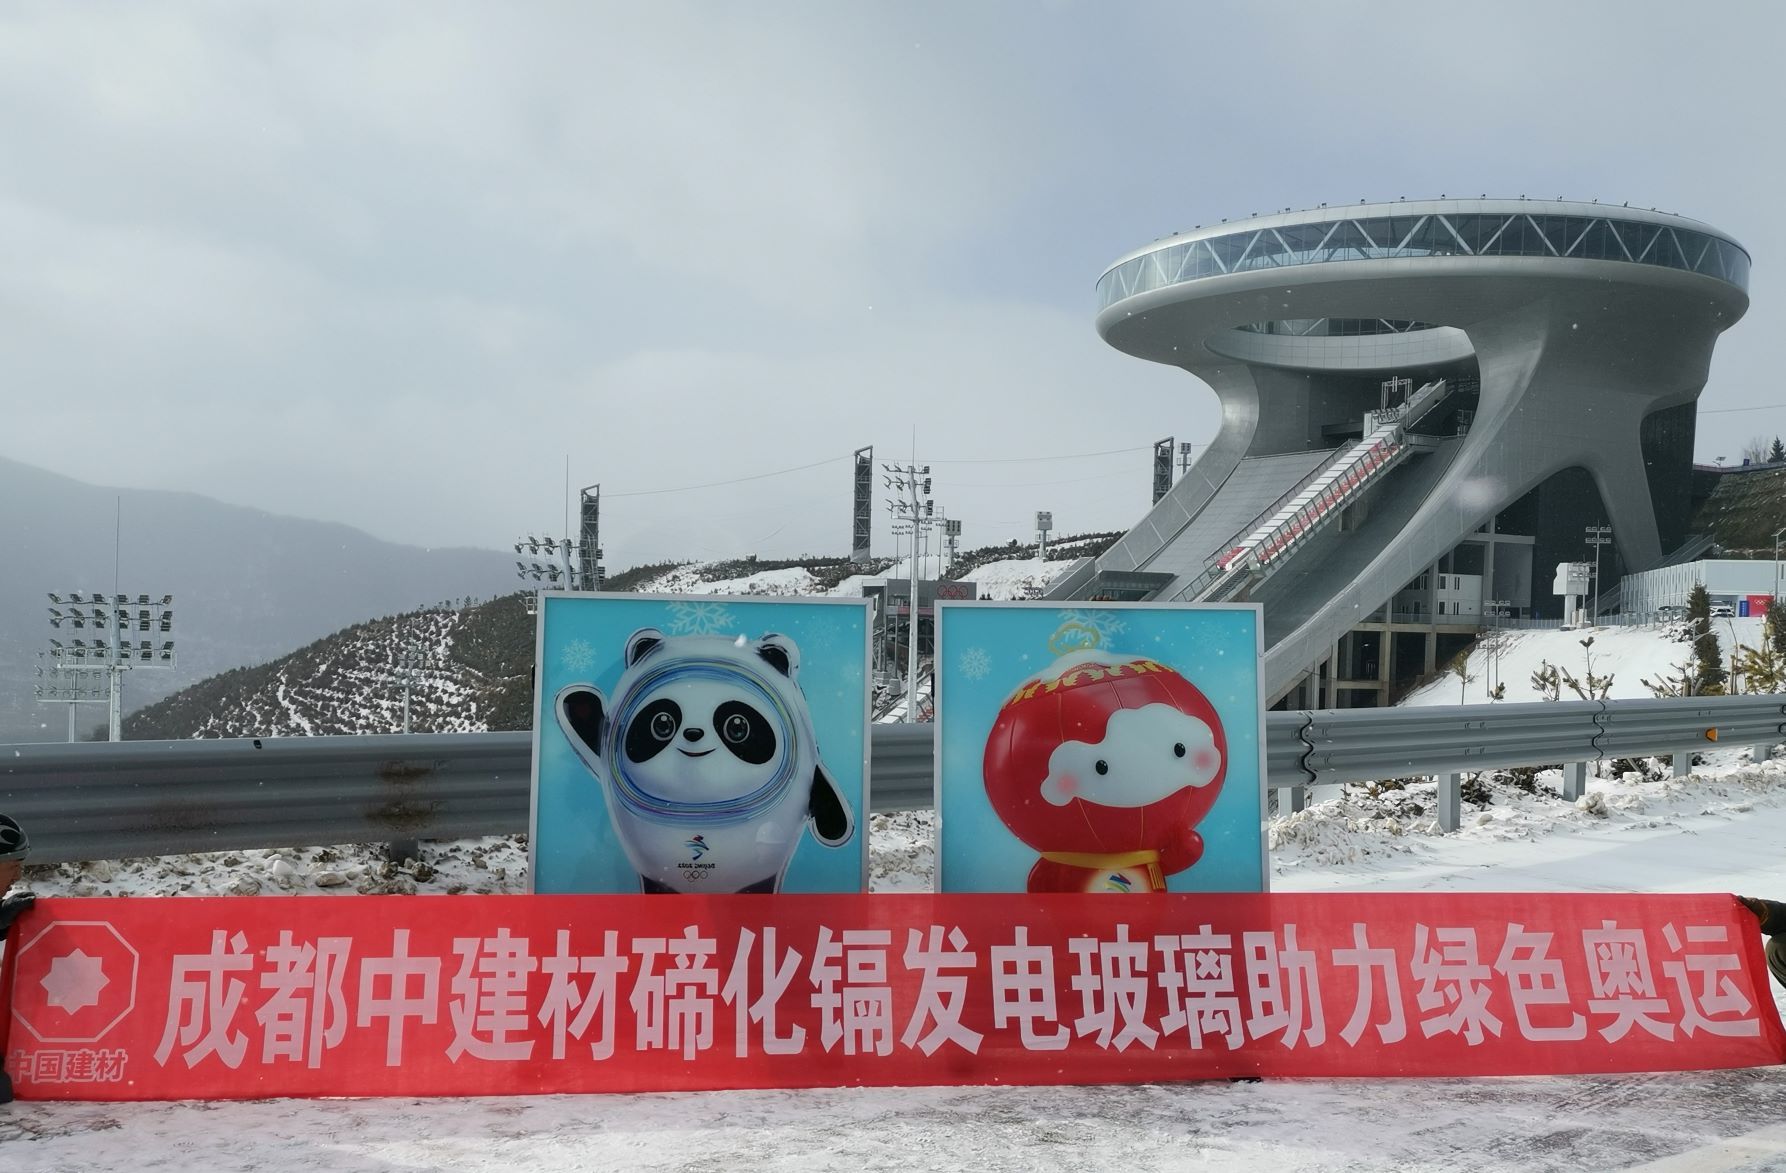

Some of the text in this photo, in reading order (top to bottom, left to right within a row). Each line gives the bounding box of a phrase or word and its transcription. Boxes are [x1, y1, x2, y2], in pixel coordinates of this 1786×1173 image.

[153, 920, 1761, 1070] 成都中建材碲化镉发电玻璃助力绿色奥运
[4, 1049, 128, 1083] 中国建材
